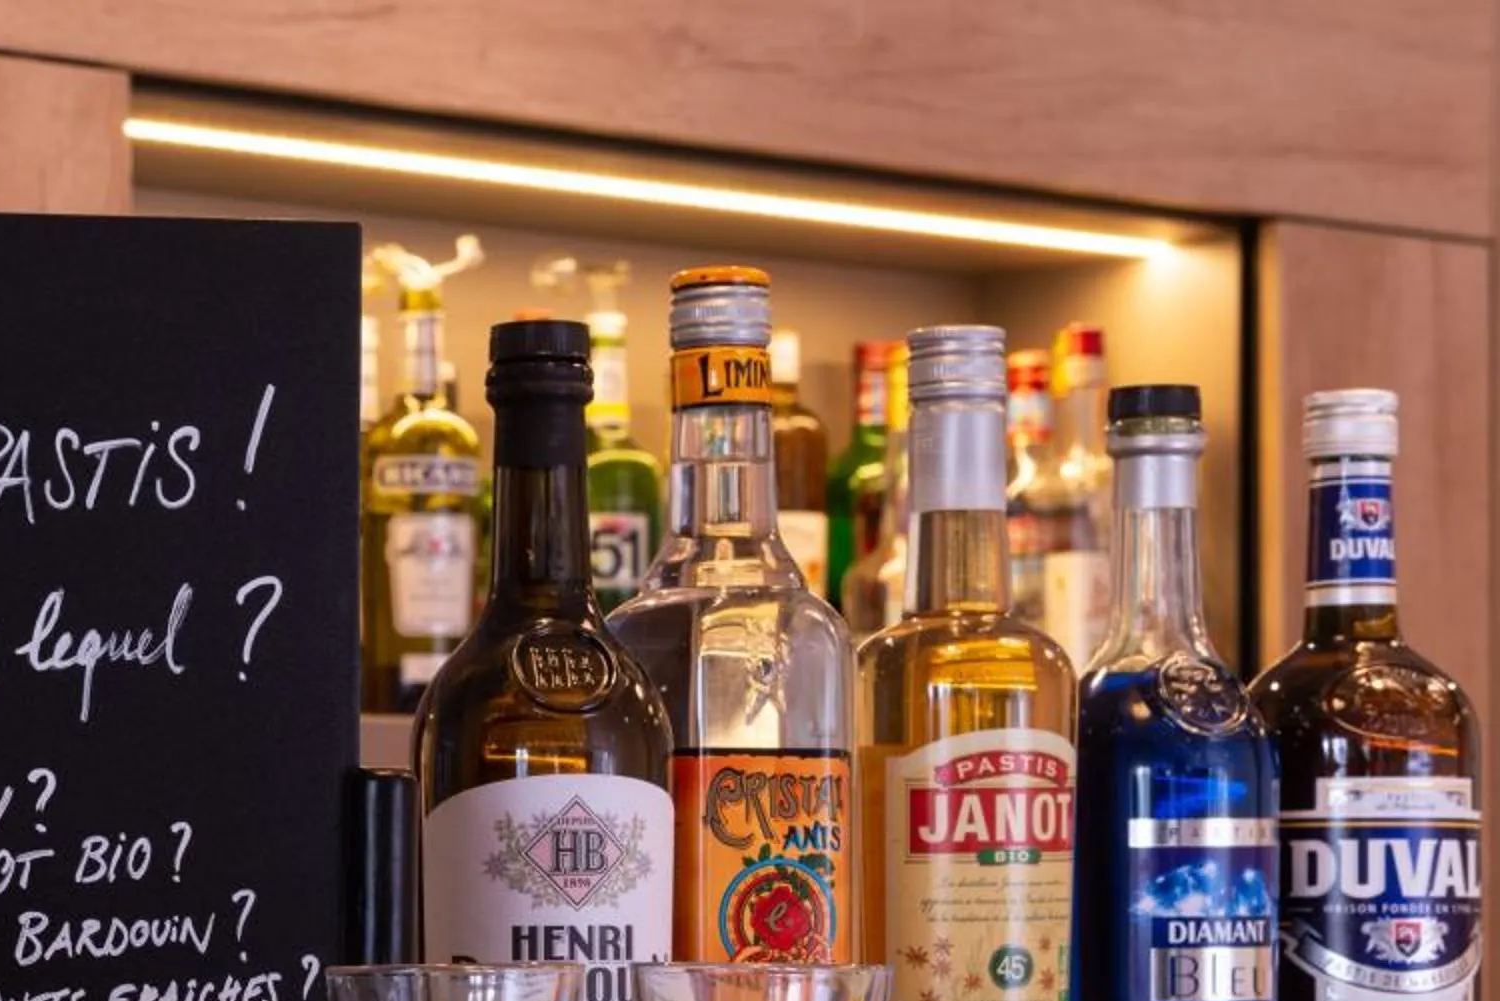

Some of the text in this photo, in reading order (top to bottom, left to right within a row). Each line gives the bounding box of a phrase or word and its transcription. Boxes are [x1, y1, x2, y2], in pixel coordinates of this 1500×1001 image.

[236, 384, 275, 510] !
[589, 529, 639, 579] 51
[16, 582, 193, 723] lequel
[236, 575, 283, 681] ?
[956, 754, 1058, 779] PASTIS
[783, 820, 841, 850] ANIS
[918, 792, 1072, 844] JANOT
[170, 821, 193, 883] ?
[551, 830, 607, 873] HB
[993, 850, 1030, 863] BIO
[1289, 838, 1481, 898] DUVAL
[231, 889, 256, 963] ?
[511, 924, 633, 962] HENRI
[1167, 920, 1266, 945] DIAMANT
[996, 955, 1028, 981] 45
